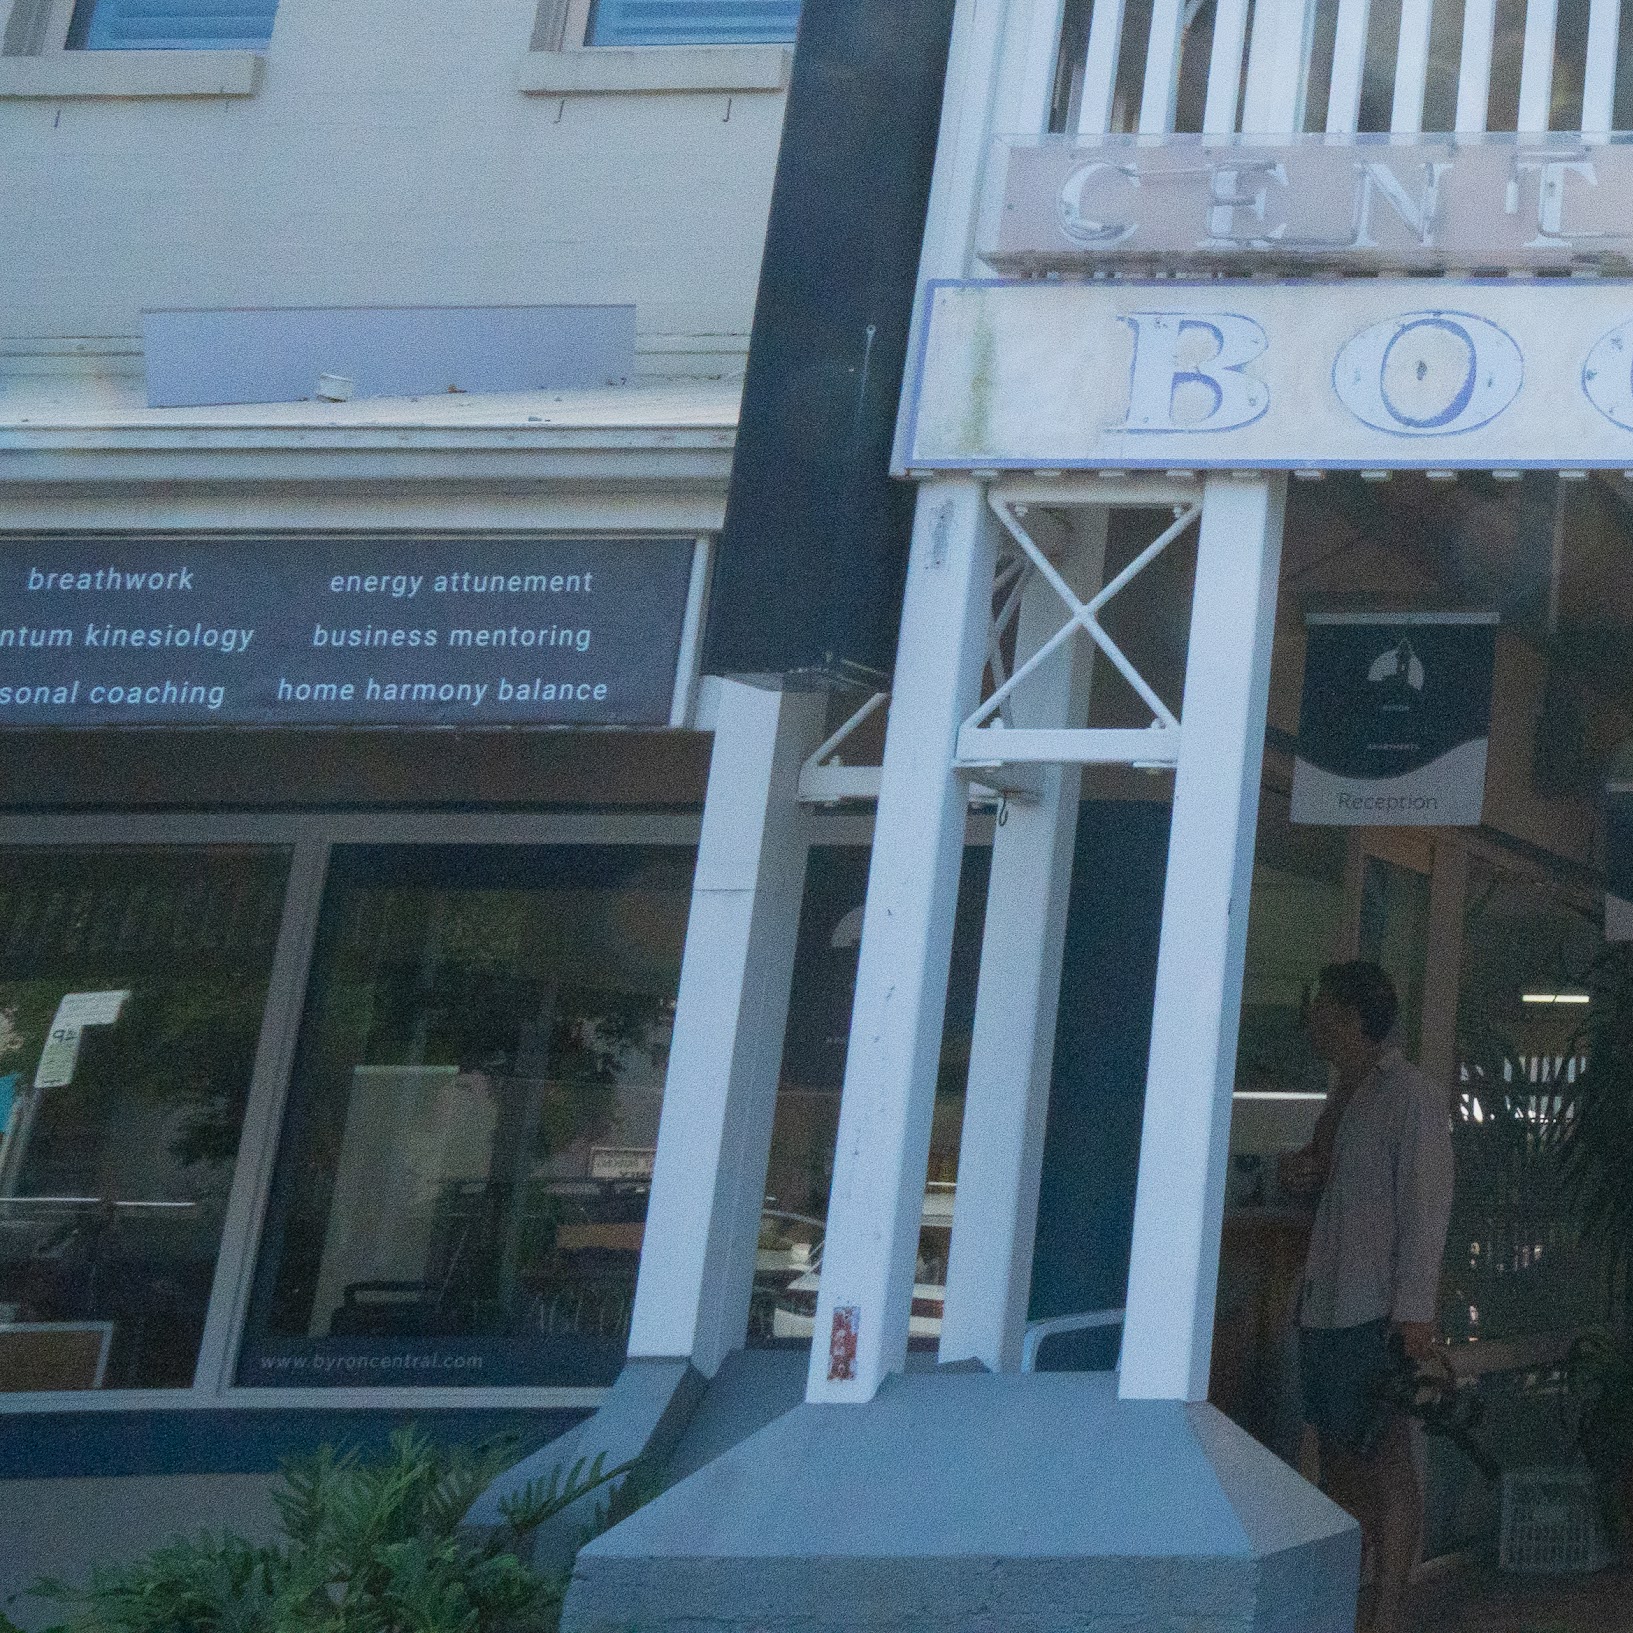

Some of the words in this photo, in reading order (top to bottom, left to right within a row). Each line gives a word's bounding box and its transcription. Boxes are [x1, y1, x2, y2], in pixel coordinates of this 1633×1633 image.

[27, 567, 194, 590] breathwork
[330, 573, 423, 597] energy
[433, 572, 593, 592] attunement
[85, 623, 254, 651] kinesiology
[313, 625, 438, 647] business
[449, 625, 591, 652] mentoring
[89, 679, 225, 709] coaching
[277, 678, 355, 701] home
[365, 678, 488, 706] harmony
[499, 678, 608, 701] balance
[1338, 792, 1439, 815] Reception
[259, 1352, 484, 1372] www.byroncentral.com
